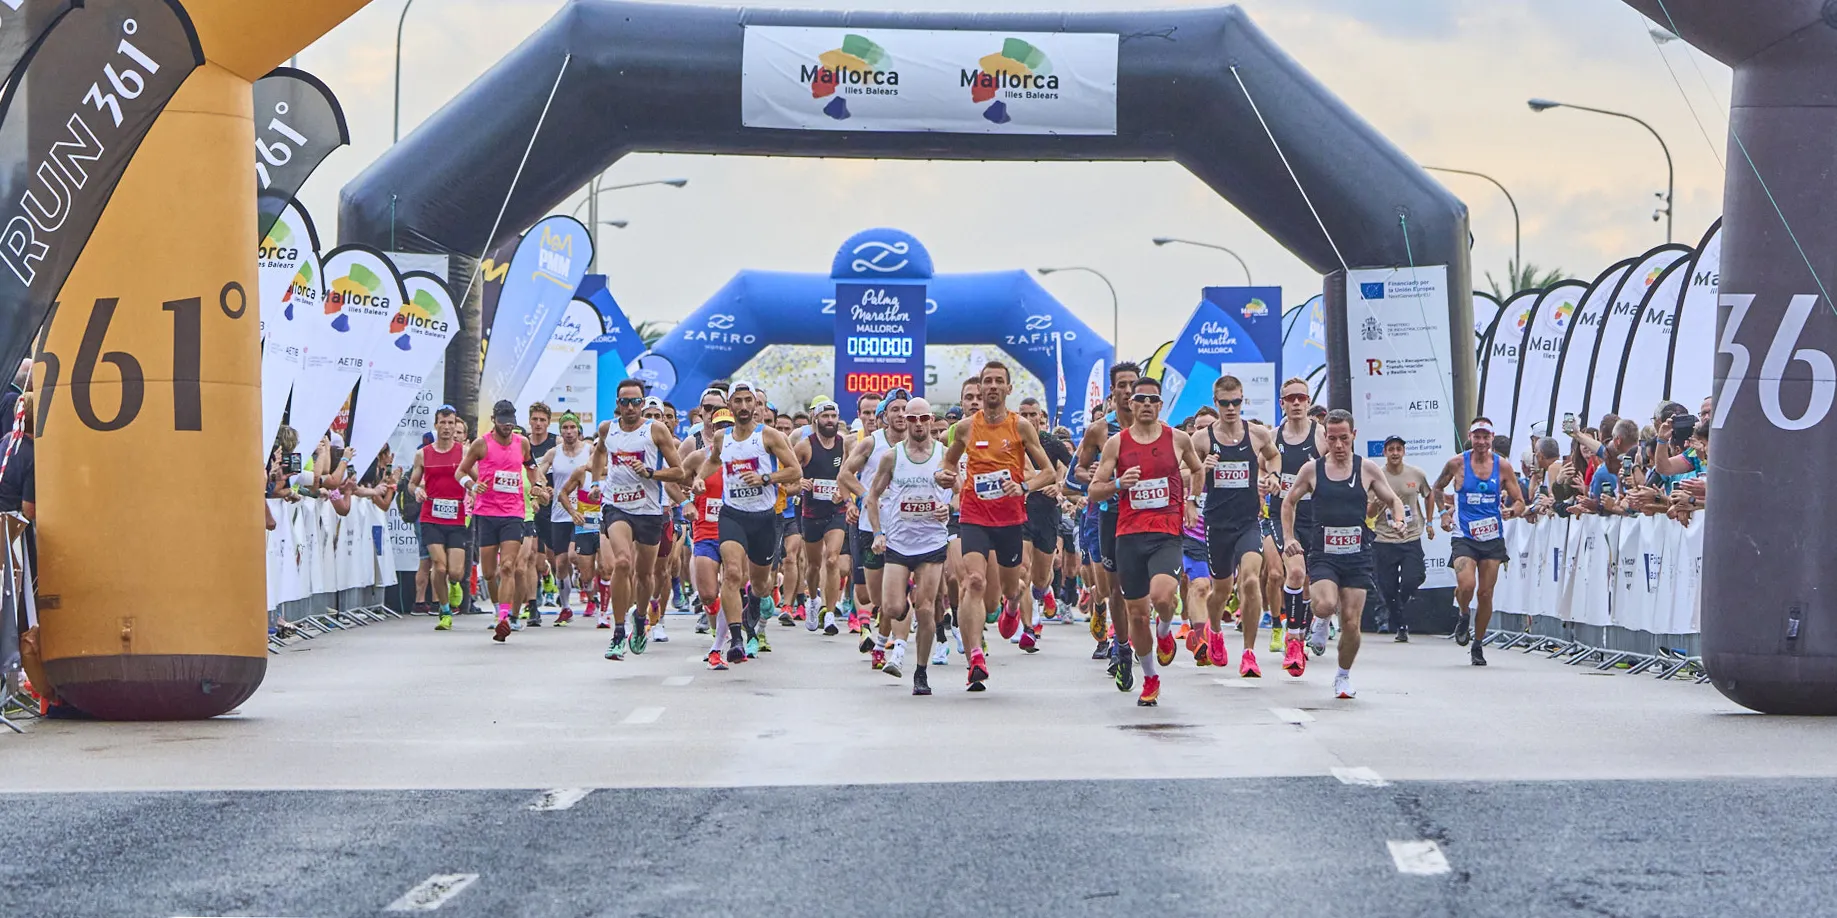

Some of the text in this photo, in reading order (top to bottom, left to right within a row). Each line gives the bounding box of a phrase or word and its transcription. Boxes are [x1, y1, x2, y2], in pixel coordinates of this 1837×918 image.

[800, 64, 899, 86] Mallorca
[960, 68, 1059, 90] Mallorca
[866, 87, 898, 96] Balears
[1026, 91, 1058, 100] Balears
[0, 18, 161, 288] RUN 361°
[862, 289, 899, 306] Palma
[364, 308, 388, 316] Balears
[851, 305, 910, 322] Marathon
[857, 325, 904, 333] MALLORCA
[1193, 334, 1237, 346] Marathon
[338, 358, 363, 367] AETIB
[399, 374, 422, 384] AETIB
[1409, 400, 1439, 410] AETIB
[617, 492, 641, 502] 4974
[733, 488, 759, 497] 1039
[1135, 489, 1164, 499] 4810
[904, 503, 932, 511] 4798
[1330, 536, 1357, 545] 4136
